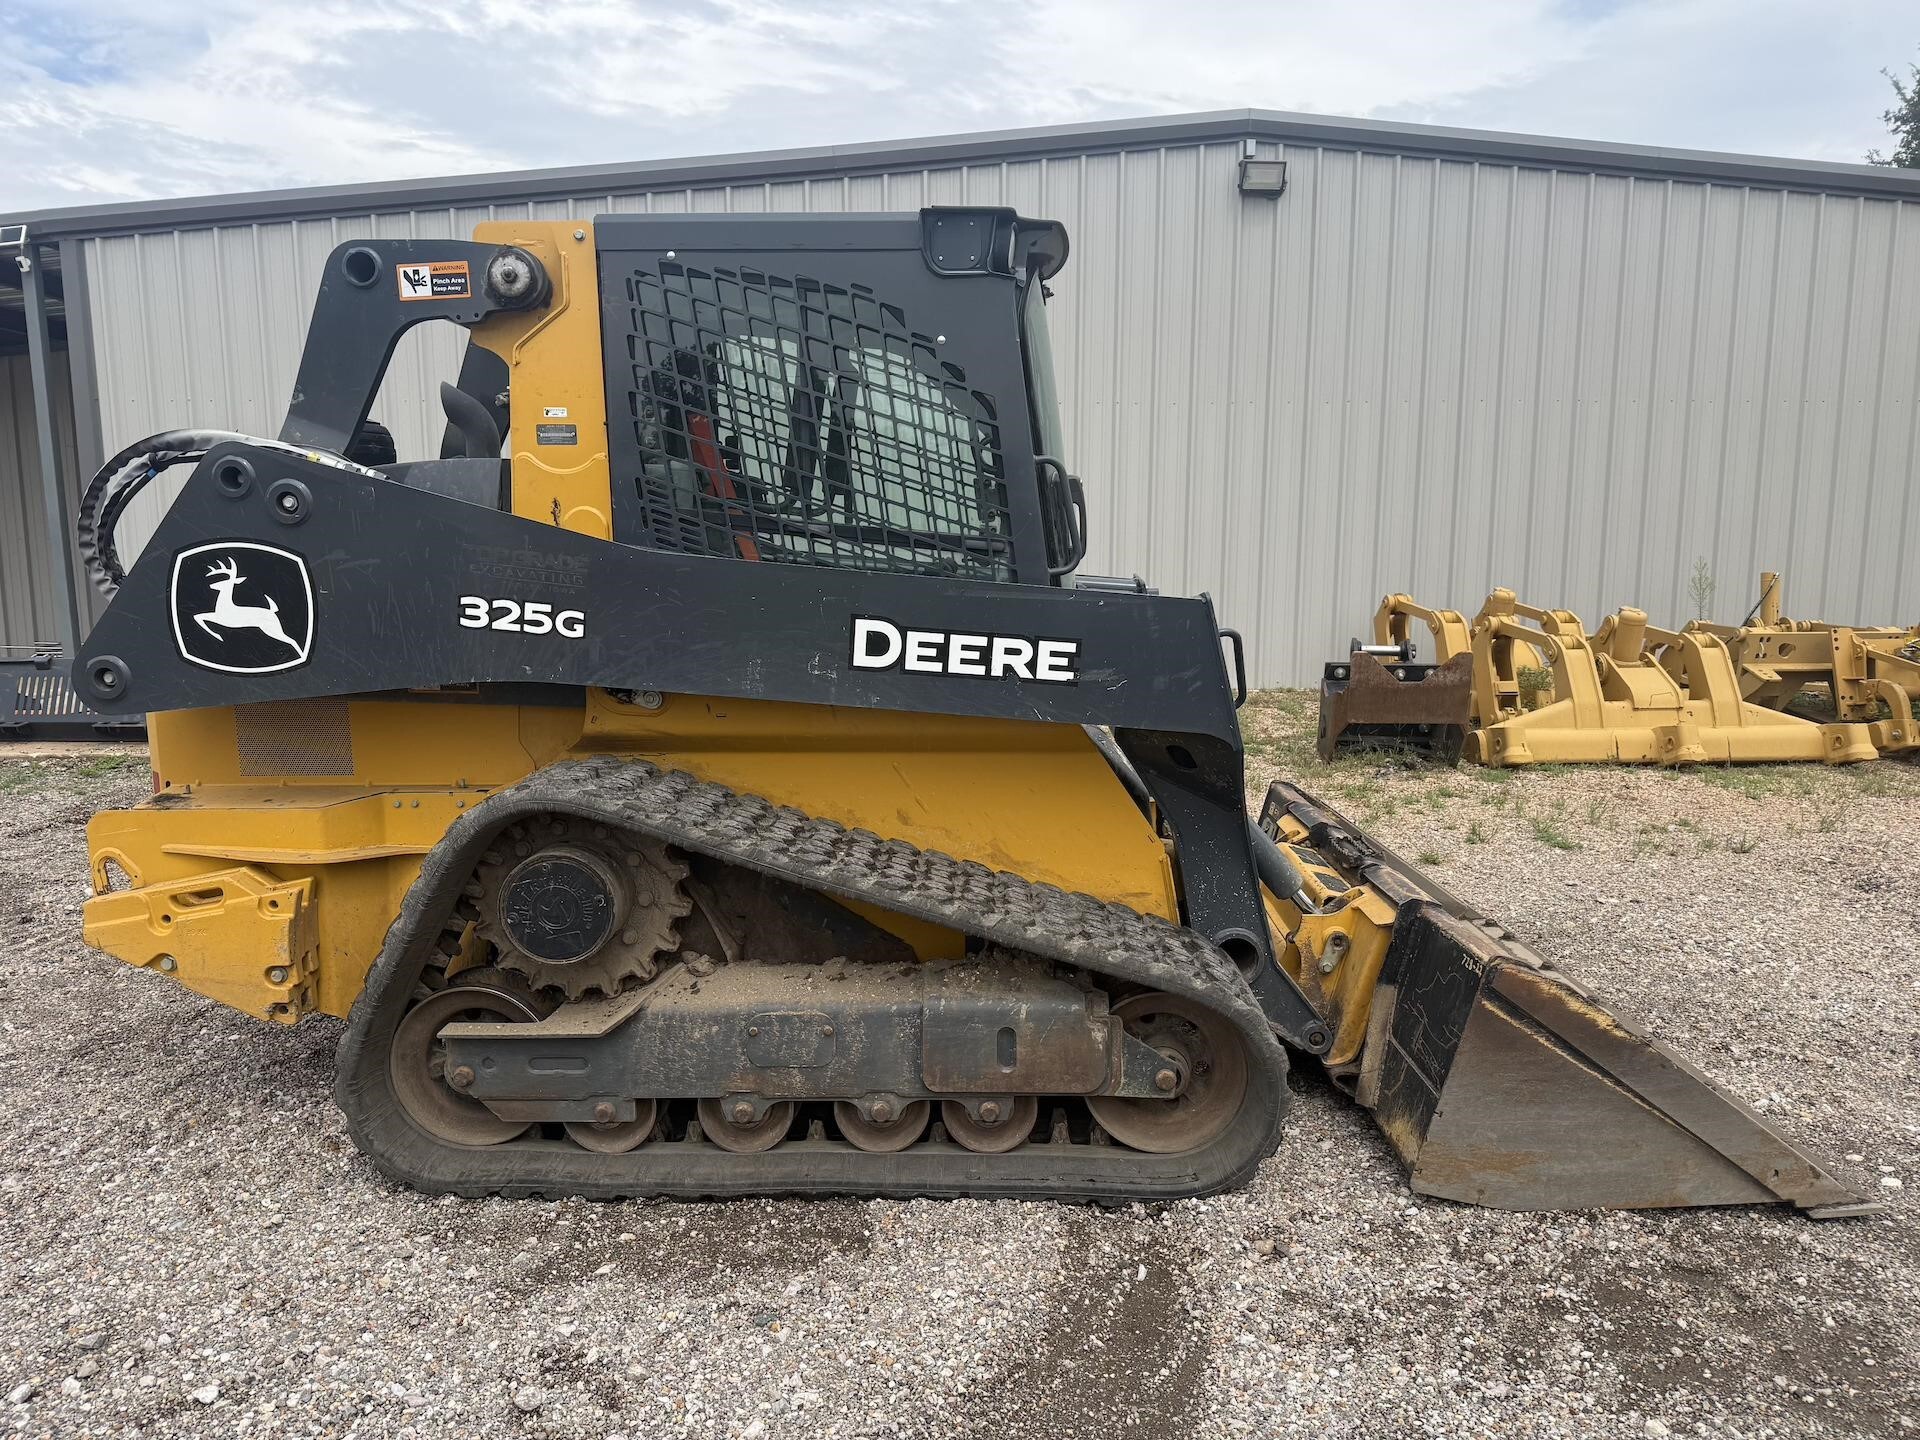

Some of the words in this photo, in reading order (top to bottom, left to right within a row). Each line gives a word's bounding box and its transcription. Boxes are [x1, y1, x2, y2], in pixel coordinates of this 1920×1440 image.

[437, 264, 465, 272] WARNING
[432, 277, 451, 285] Pinch
[451, 276, 466, 284] Area
[433, 285, 447, 293] Keep
[469, 563, 584, 585] EXCAVATING
[459, 596, 585, 639] 325G
[852, 617, 1078, 682] DEERE
